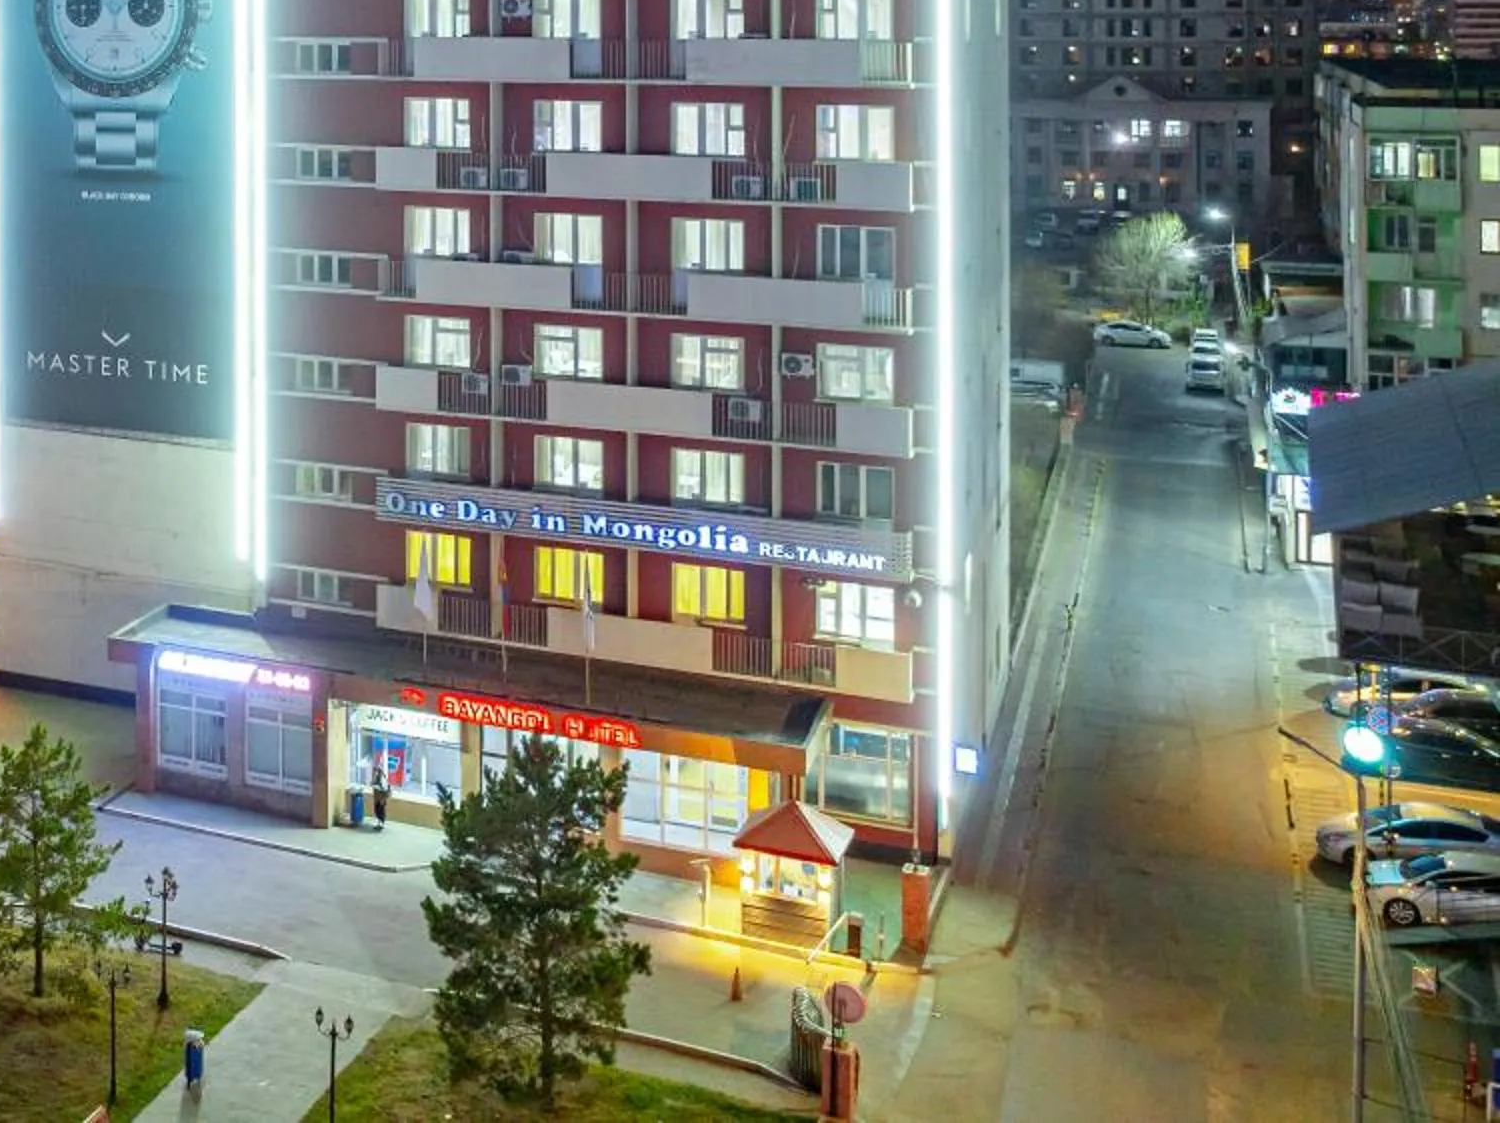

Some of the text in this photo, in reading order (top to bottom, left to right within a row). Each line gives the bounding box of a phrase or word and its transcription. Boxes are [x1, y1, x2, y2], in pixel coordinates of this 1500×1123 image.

[27, 351, 210, 385] MASTER TIME
[385, 491, 446, 518] One
[457, 499, 517, 530] Day
[531, 506, 566, 532] in
[583, 514, 749, 554] Mongolia
